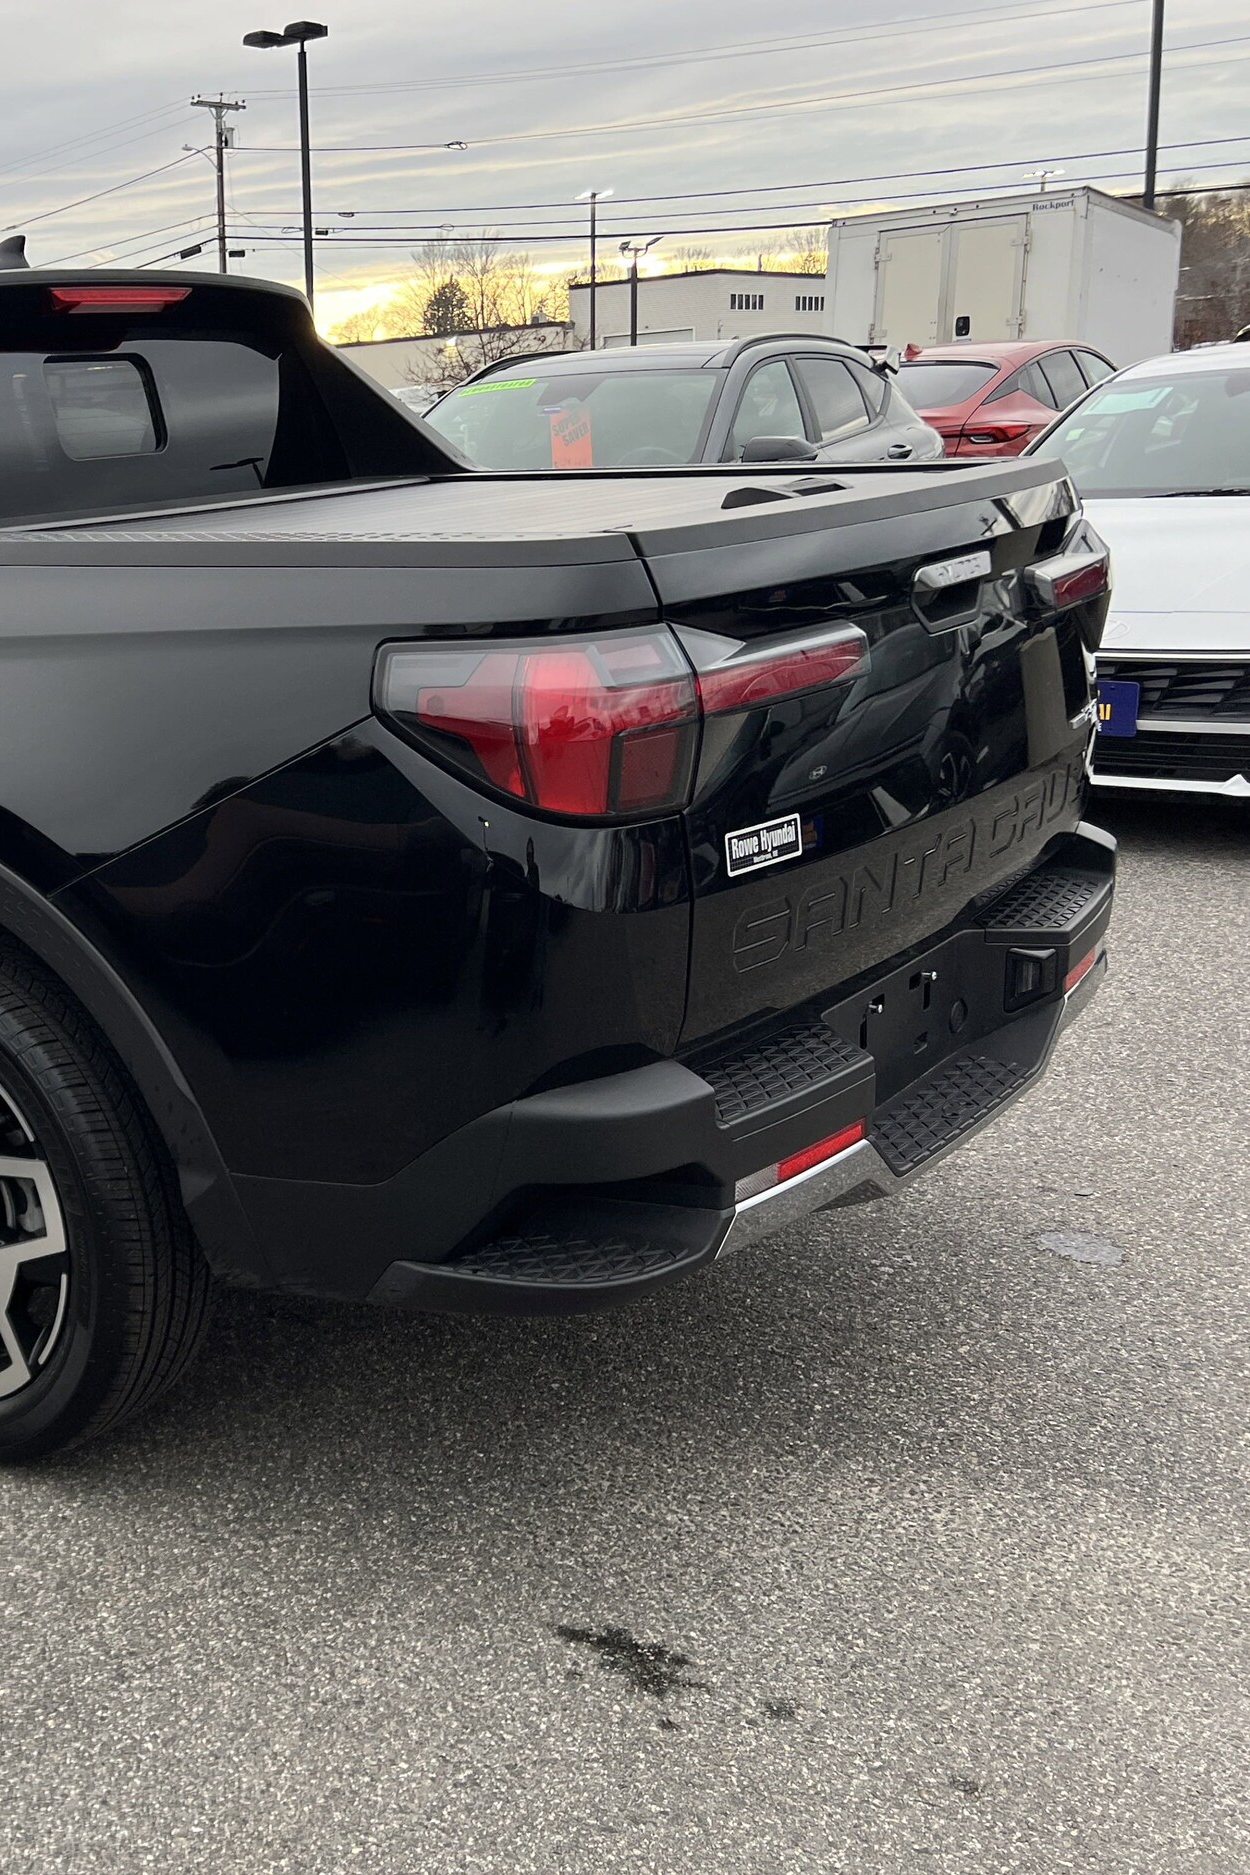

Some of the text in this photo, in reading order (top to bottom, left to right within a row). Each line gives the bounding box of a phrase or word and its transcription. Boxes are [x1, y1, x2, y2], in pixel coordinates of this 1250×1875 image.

[1032, 199, 1074, 211] Rockport
[562, 421, 589, 447] SAVER
[731, 836, 759, 860] Rowe
[760, 821, 796, 853] Hyundai
[733, 817, 976, 974] SANTA
